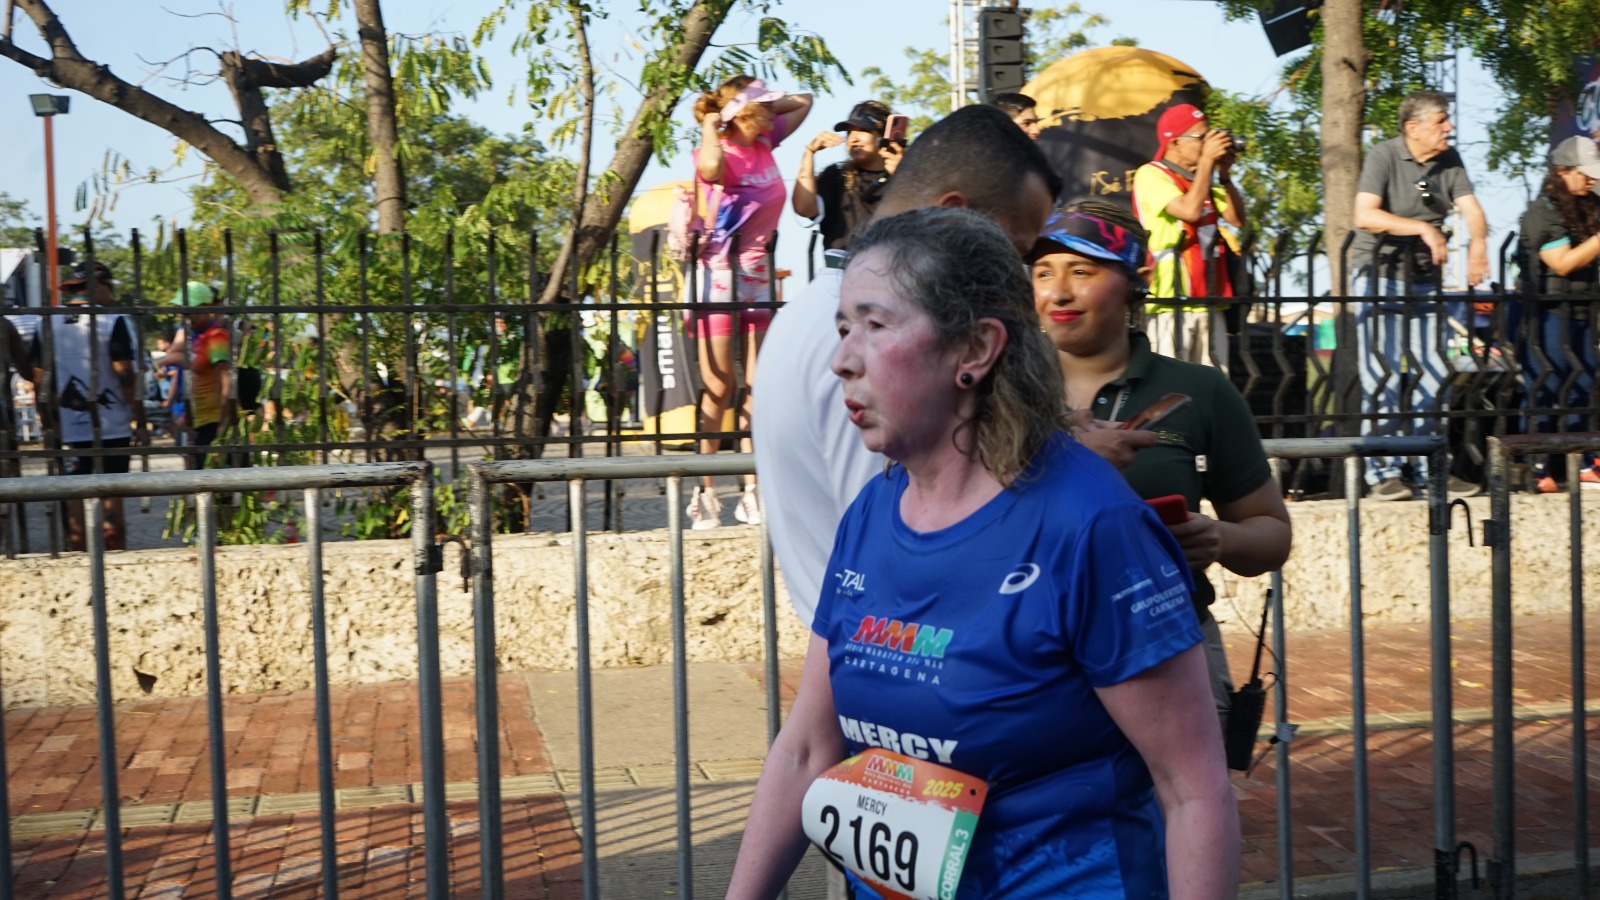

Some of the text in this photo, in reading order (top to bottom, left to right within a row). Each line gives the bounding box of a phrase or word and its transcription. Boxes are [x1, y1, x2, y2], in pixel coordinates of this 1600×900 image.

[835, 569, 866, 592] TAL
[850, 615, 954, 658] MMM
[844, 655, 941, 685] CARTAGENA
[838, 714, 959, 764] MERCY
[865, 754, 913, 783] MMM
[922, 778, 964, 799] 2025
[856, 794, 888, 817] MERCY
[820, 804, 919, 893] 2169
[940, 828, 969, 900] CORRAL 3
